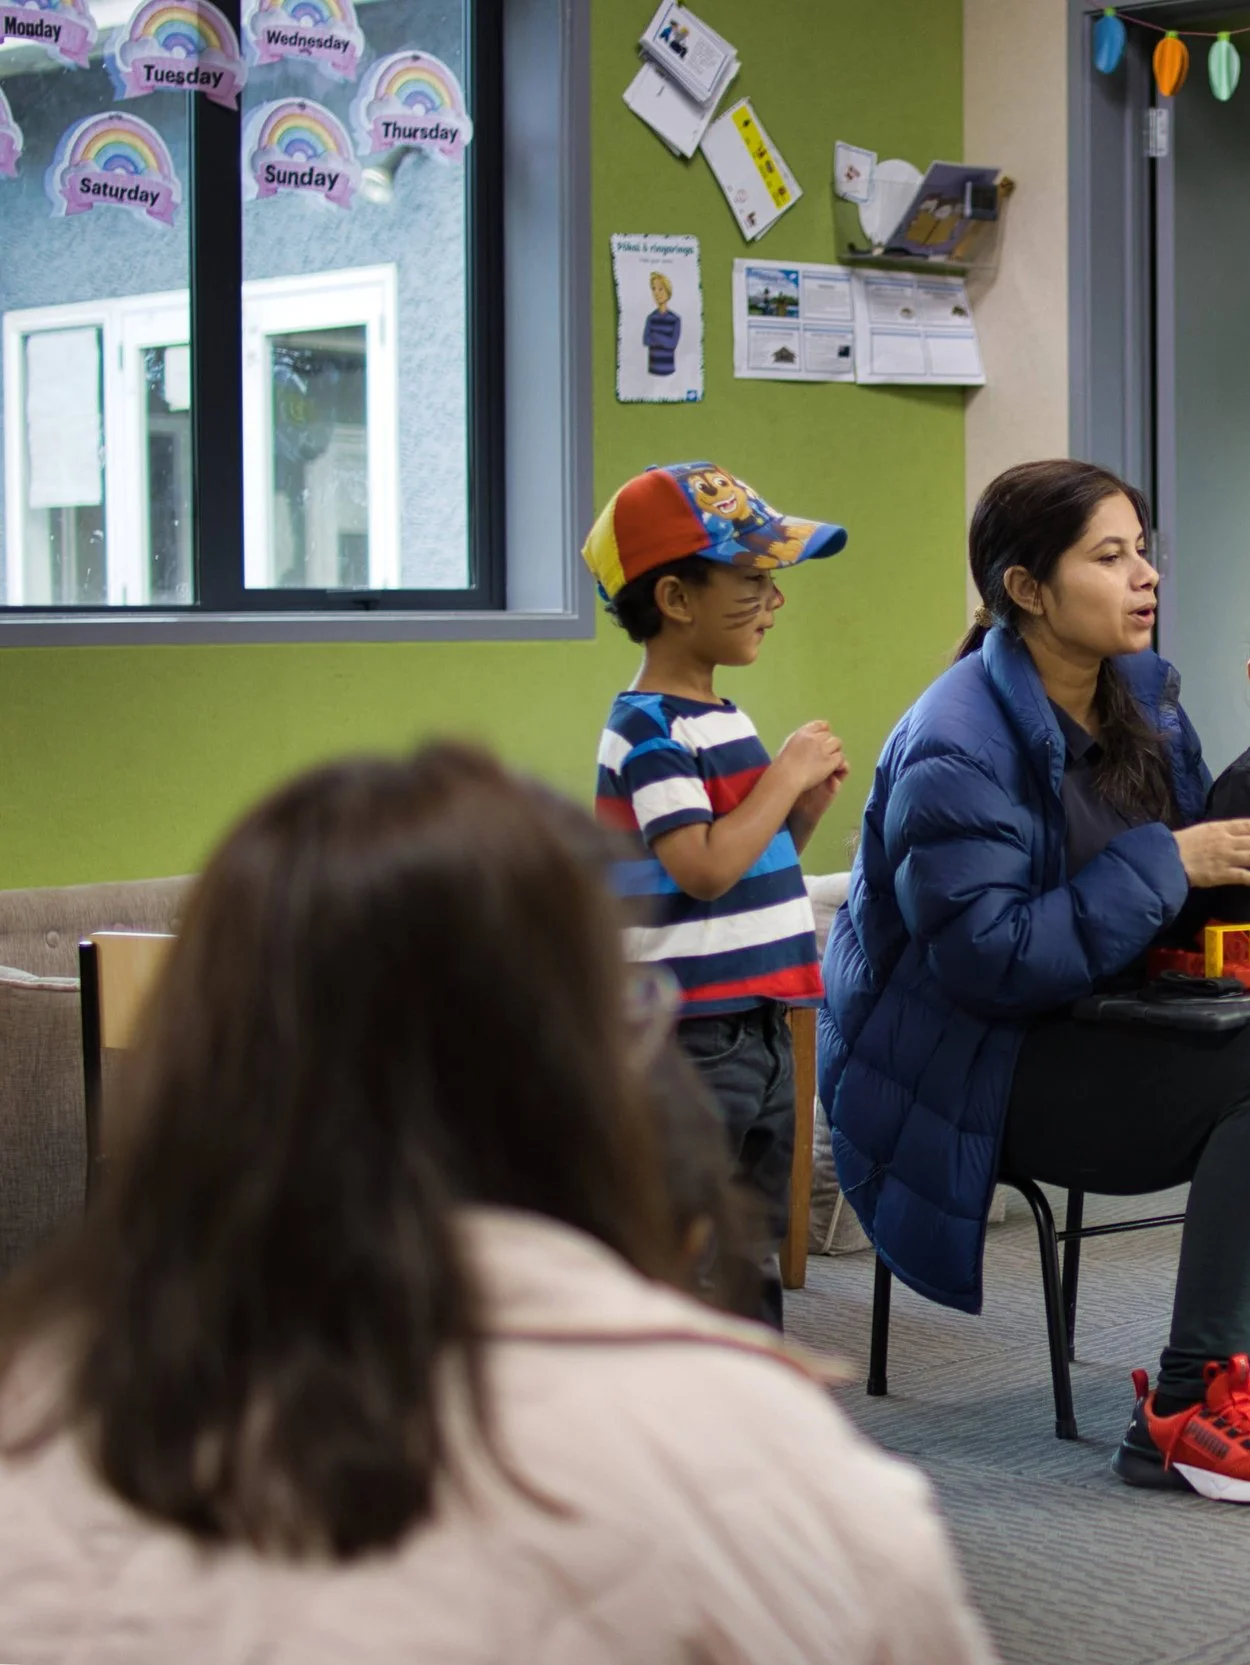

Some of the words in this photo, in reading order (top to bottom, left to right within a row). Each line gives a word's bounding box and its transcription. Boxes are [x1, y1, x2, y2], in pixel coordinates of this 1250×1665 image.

[3, 16, 63, 43] Monday
[265, 30, 351, 54] Wednesday
[142, 64, 224, 88] Tuesday
[381, 121, 459, 143] Thursday
[264, 164, 340, 191] Sunday
[79, 176, 161, 207] Saturday
